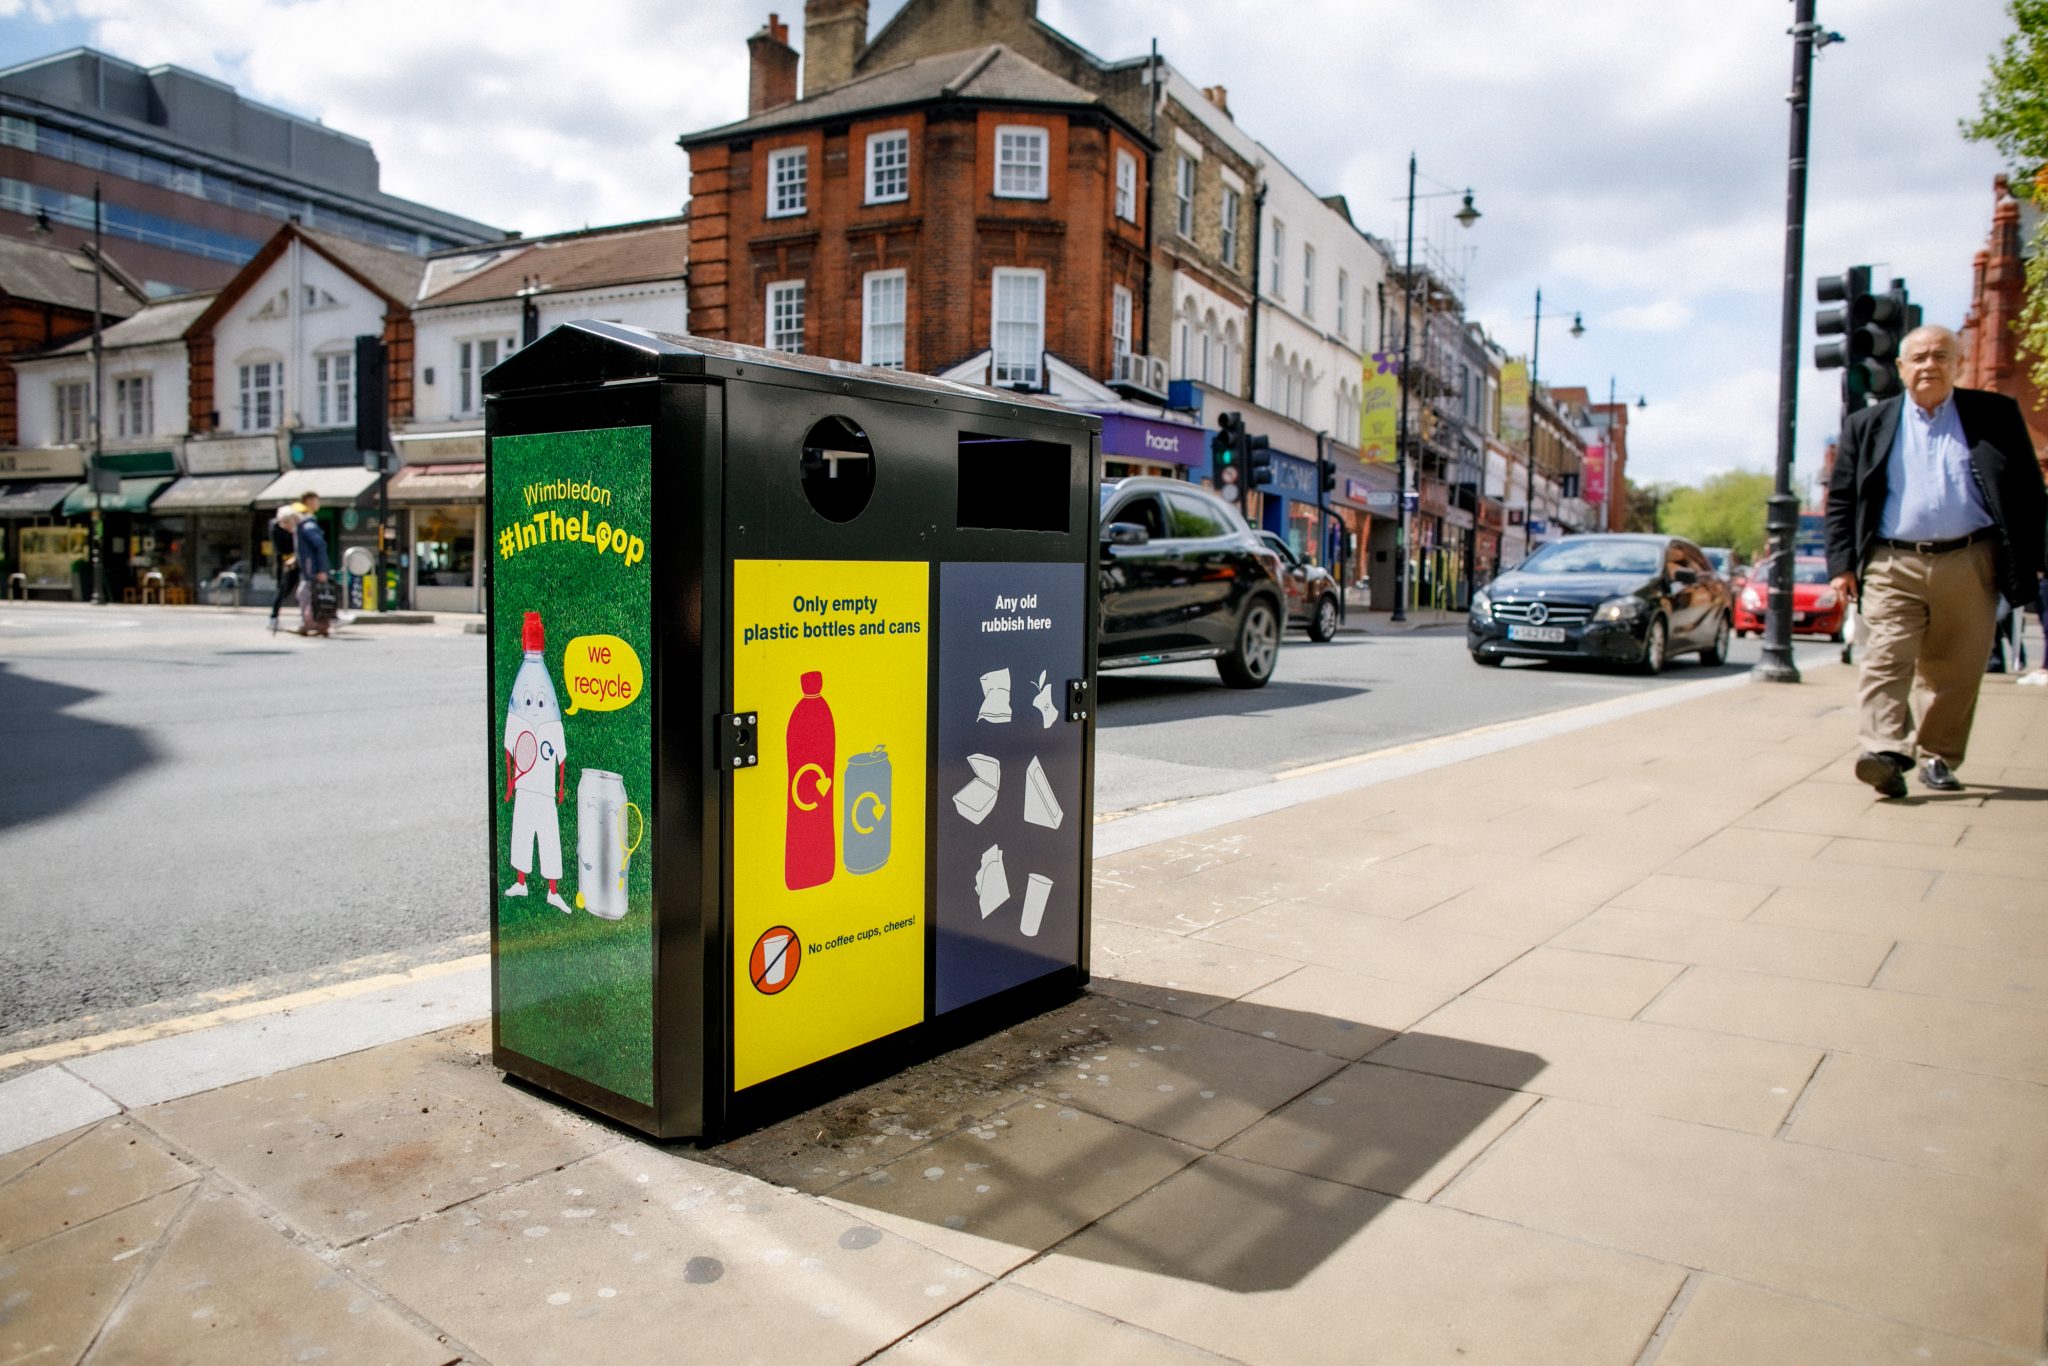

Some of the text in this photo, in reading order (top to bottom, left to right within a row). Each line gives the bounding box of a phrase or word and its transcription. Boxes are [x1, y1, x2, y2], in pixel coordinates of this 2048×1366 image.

[1145, 429, 1179, 452] haart
[524, 478, 611, 506] Wimbledon
[499, 510, 645, 567] #InTheLoop
[793, 595, 878, 616] Only empty
[994, 593, 1038, 613] Any old
[744, 619, 921, 646] plastic bottles and cans
[981, 615, 1052, 633] rubbish here
[587, 645, 612, 665] we
[574, 673, 632, 703] recycle
[808, 915, 915, 955] No coffee cups, cheers!
